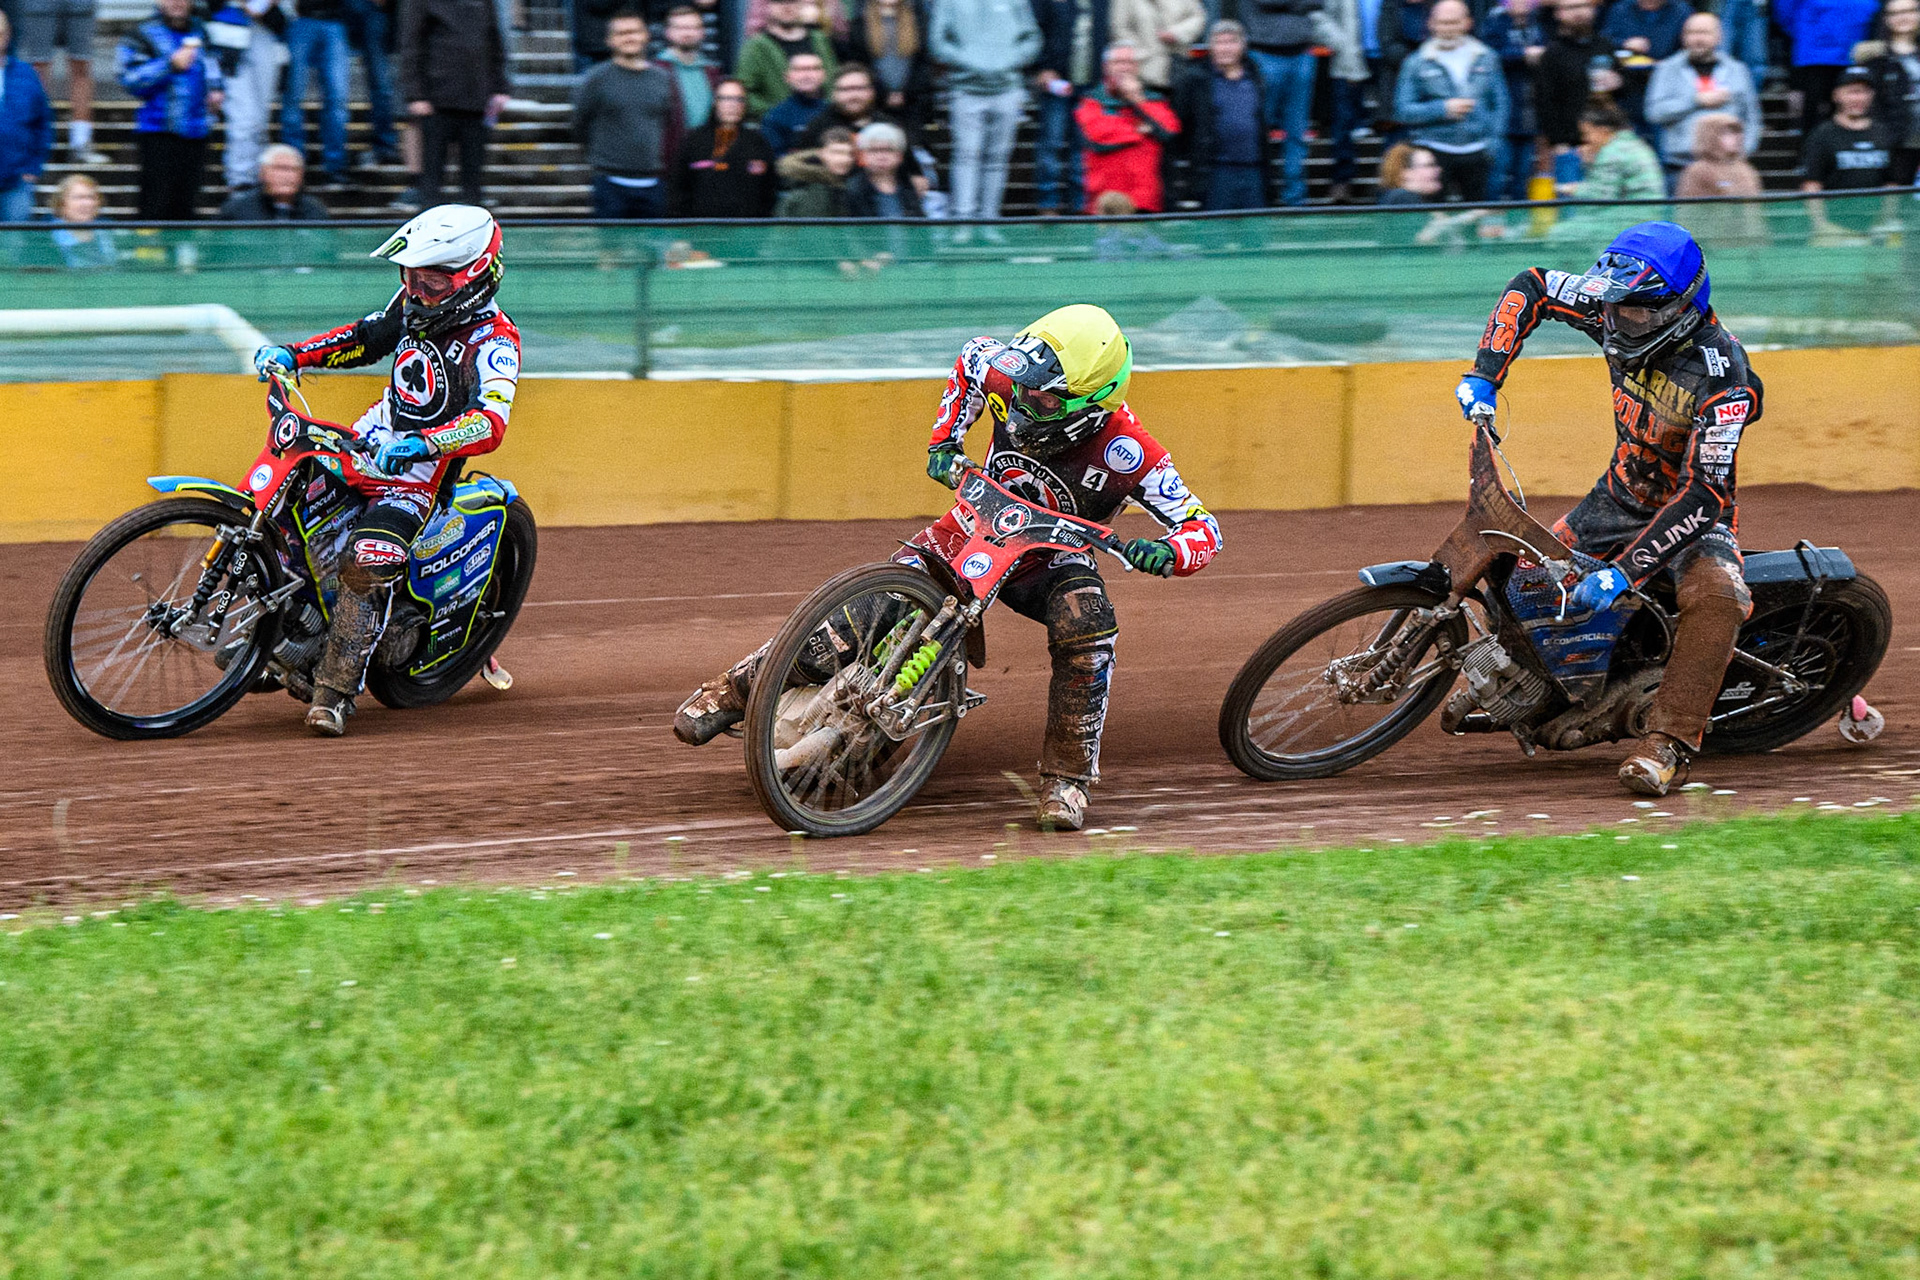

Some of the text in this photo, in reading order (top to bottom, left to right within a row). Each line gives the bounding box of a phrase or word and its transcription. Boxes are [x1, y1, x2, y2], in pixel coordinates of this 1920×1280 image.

[1491, 290, 1528, 355] CFS
[448, 342, 463, 361] 3
[432, 362, 445, 389] ACES
[1718, 403, 1748, 418] NGK
[1112, 444, 1137, 466] ATPI
[995, 457, 1072, 514] BELLE VUE ACES
[1086, 471, 1103, 490] 4
[1058, 529, 1084, 548] agilia
[1651, 506, 1710, 554] LINK
[358, 541, 406, 558] CBS
[420, 520, 496, 578] POLCOPPER
[233, 552, 248, 575] GEO
[967, 559, 986, 571] ATPI
[216, 590, 231, 613] GEO
